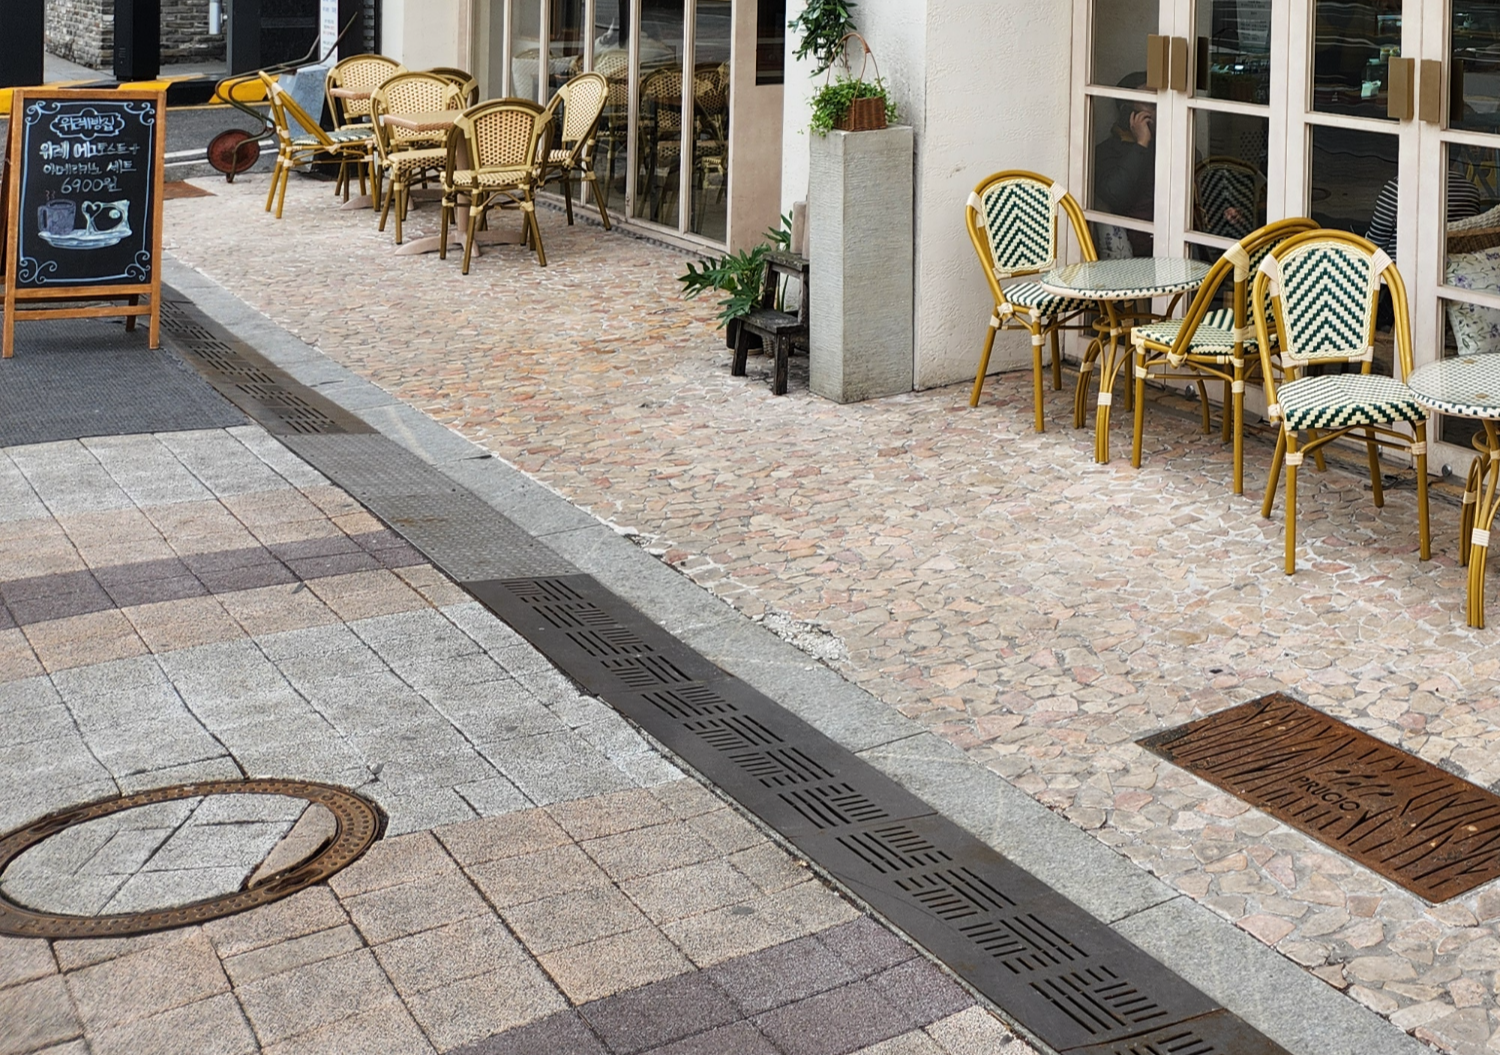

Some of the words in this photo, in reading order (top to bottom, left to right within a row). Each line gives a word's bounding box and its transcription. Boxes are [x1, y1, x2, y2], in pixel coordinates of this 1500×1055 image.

[39, 140, 70, 160] 위례
[106, 158, 137, 174] 세트
[60, 175, 122, 194] 6900원
